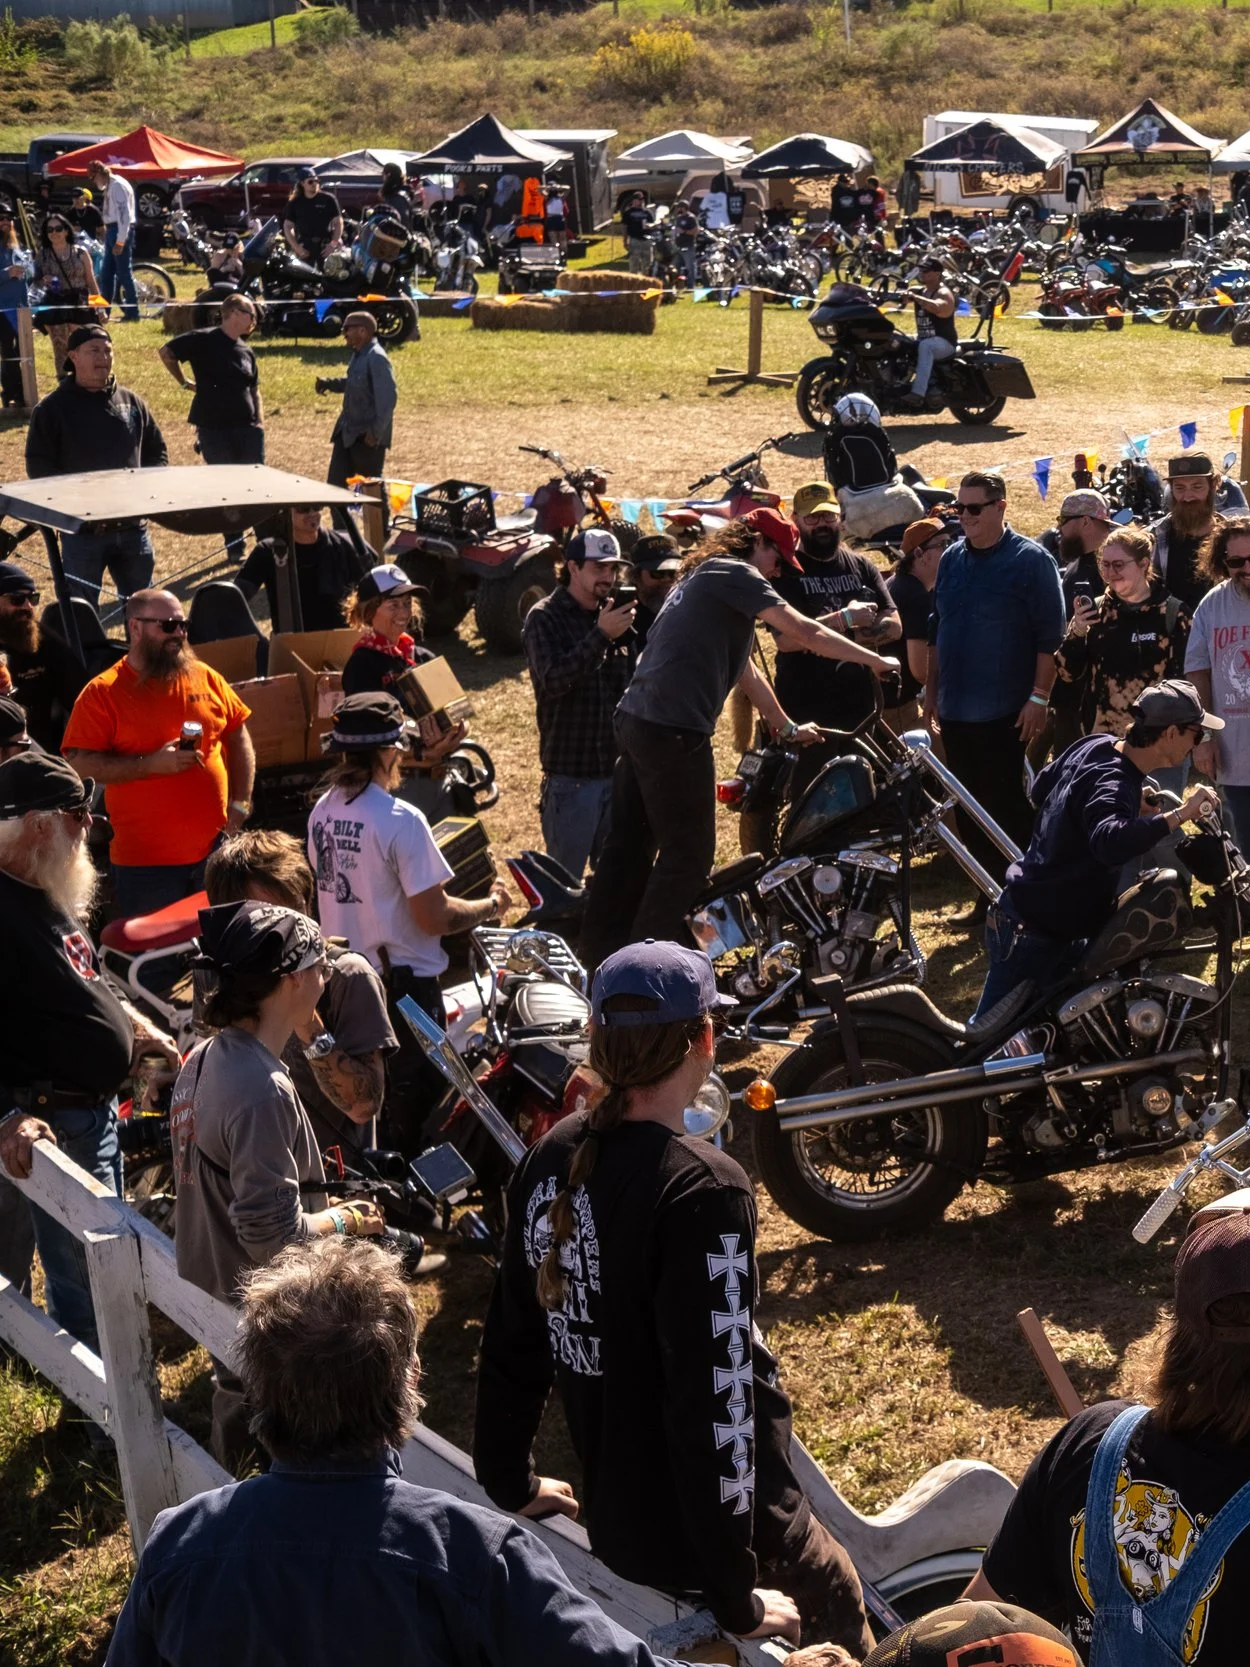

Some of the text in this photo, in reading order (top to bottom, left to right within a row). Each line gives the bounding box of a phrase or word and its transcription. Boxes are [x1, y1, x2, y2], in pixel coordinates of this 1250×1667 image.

[968, 161, 1025, 173] CHOPPERS
[800, 576, 825, 595] THE
[1213, 625, 1239, 667] JOE
[1225, 693, 1236, 705] 20
[333, 819, 364, 839] BILT
